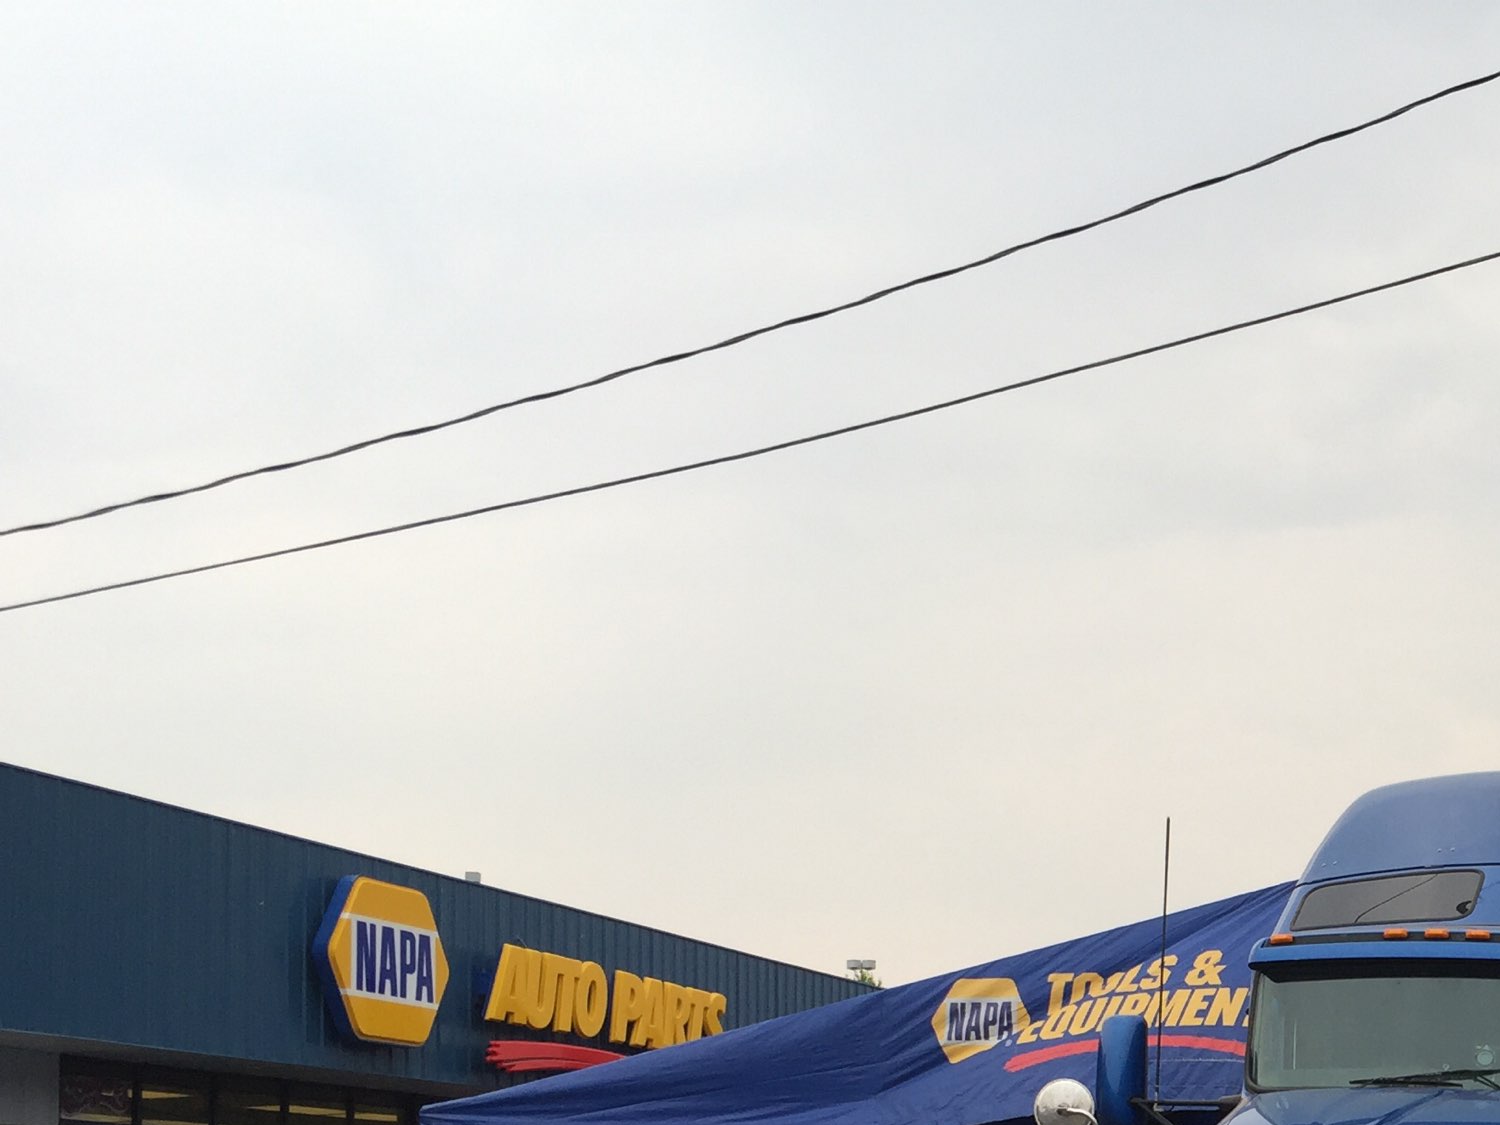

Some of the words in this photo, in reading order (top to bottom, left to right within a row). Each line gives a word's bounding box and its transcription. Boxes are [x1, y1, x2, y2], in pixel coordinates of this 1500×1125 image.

[356, 920, 434, 1004] NAPA
[1184, 949, 1227, 987] &
[485, 943, 609, 1038] AUTO
[609, 969, 728, 1050] PARTS
[946, 1001, 1013, 1042] NAPA
[1017, 987, 1249, 1044] EQUIPMEN
